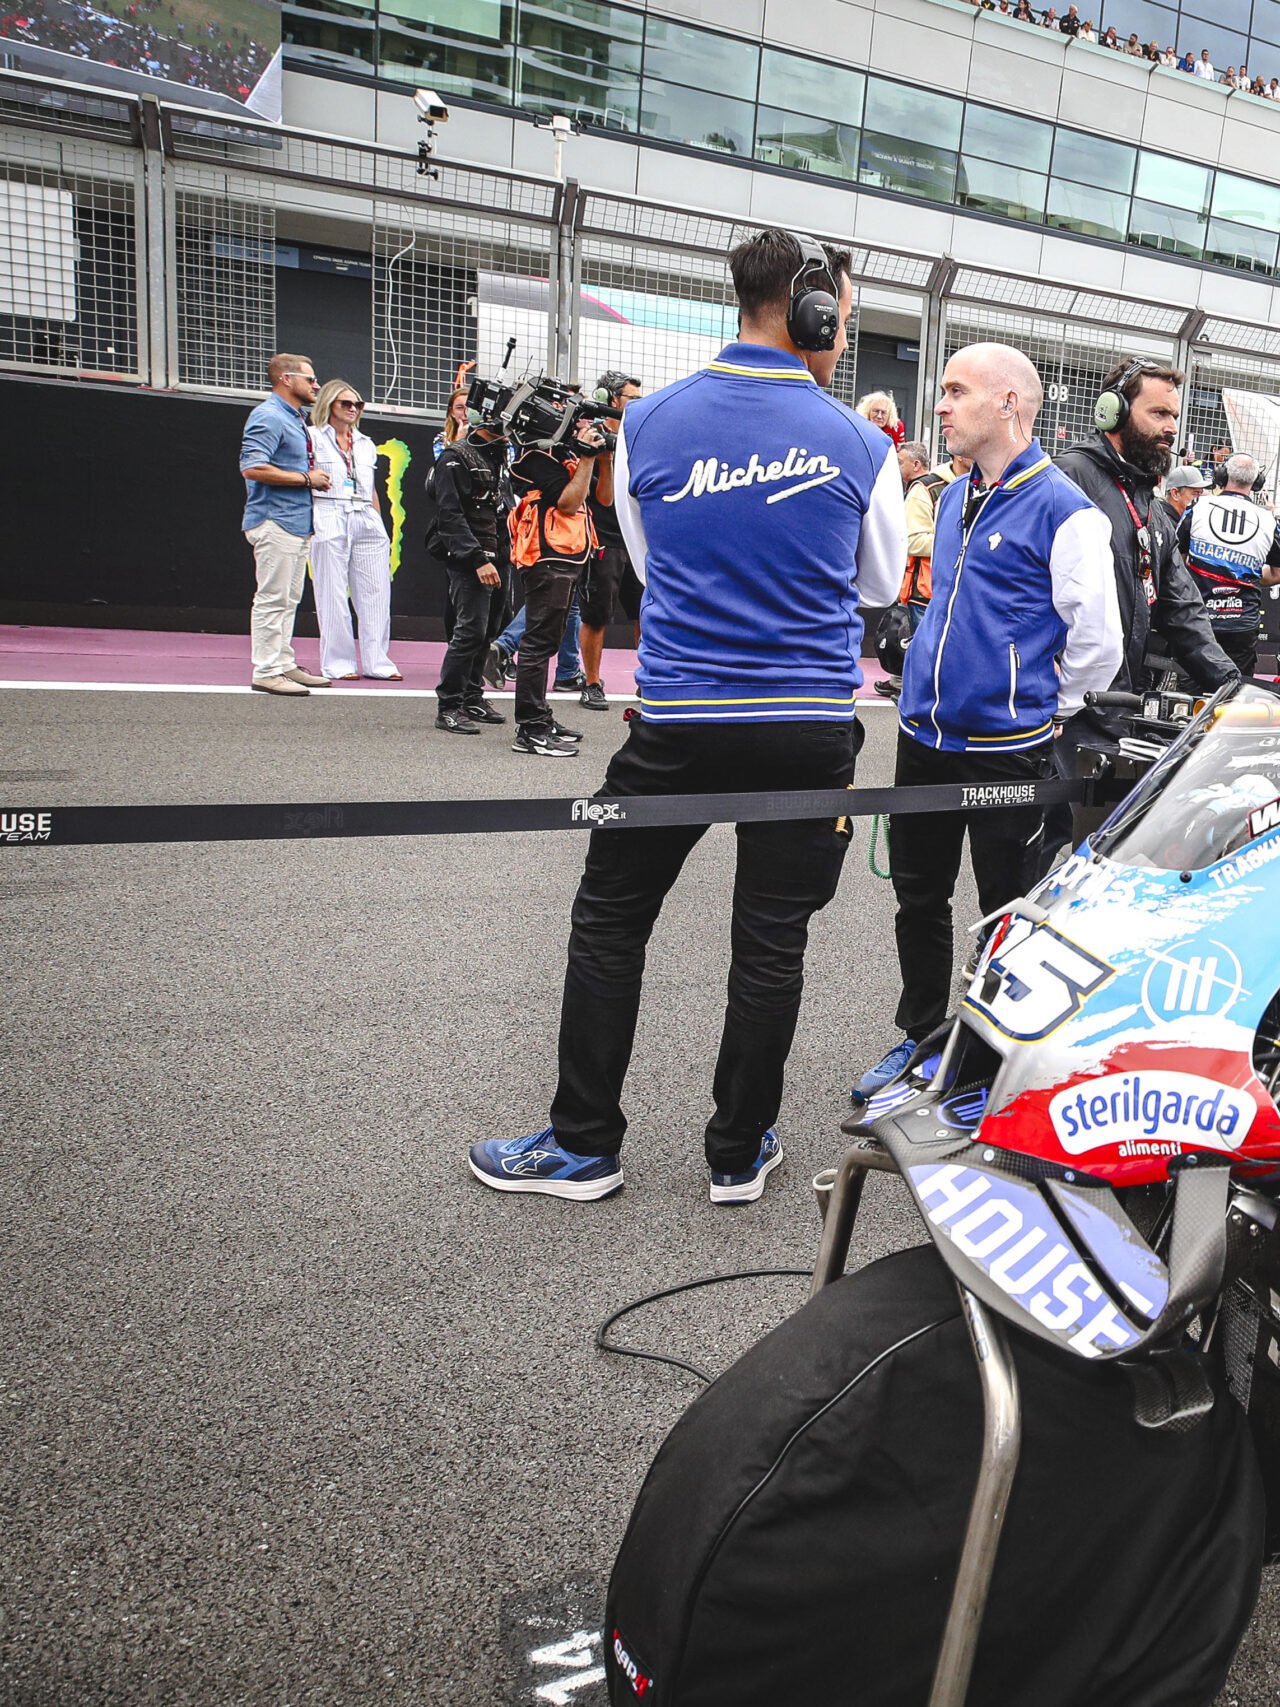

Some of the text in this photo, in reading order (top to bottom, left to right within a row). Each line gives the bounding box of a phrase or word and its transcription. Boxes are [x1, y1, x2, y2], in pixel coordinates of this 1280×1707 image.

[1048, 384, 1069, 402] 08
[662, 447, 841, 504] Michelin
[1206, 596, 1243, 611] aprilia
[962, 785, 1036, 801] TRACKHOUSE
[961, 798, 1011, 807] RACING
[1061, 1076, 1240, 1137] sterilgarda
[1117, 1140, 1182, 1157] alimenti
